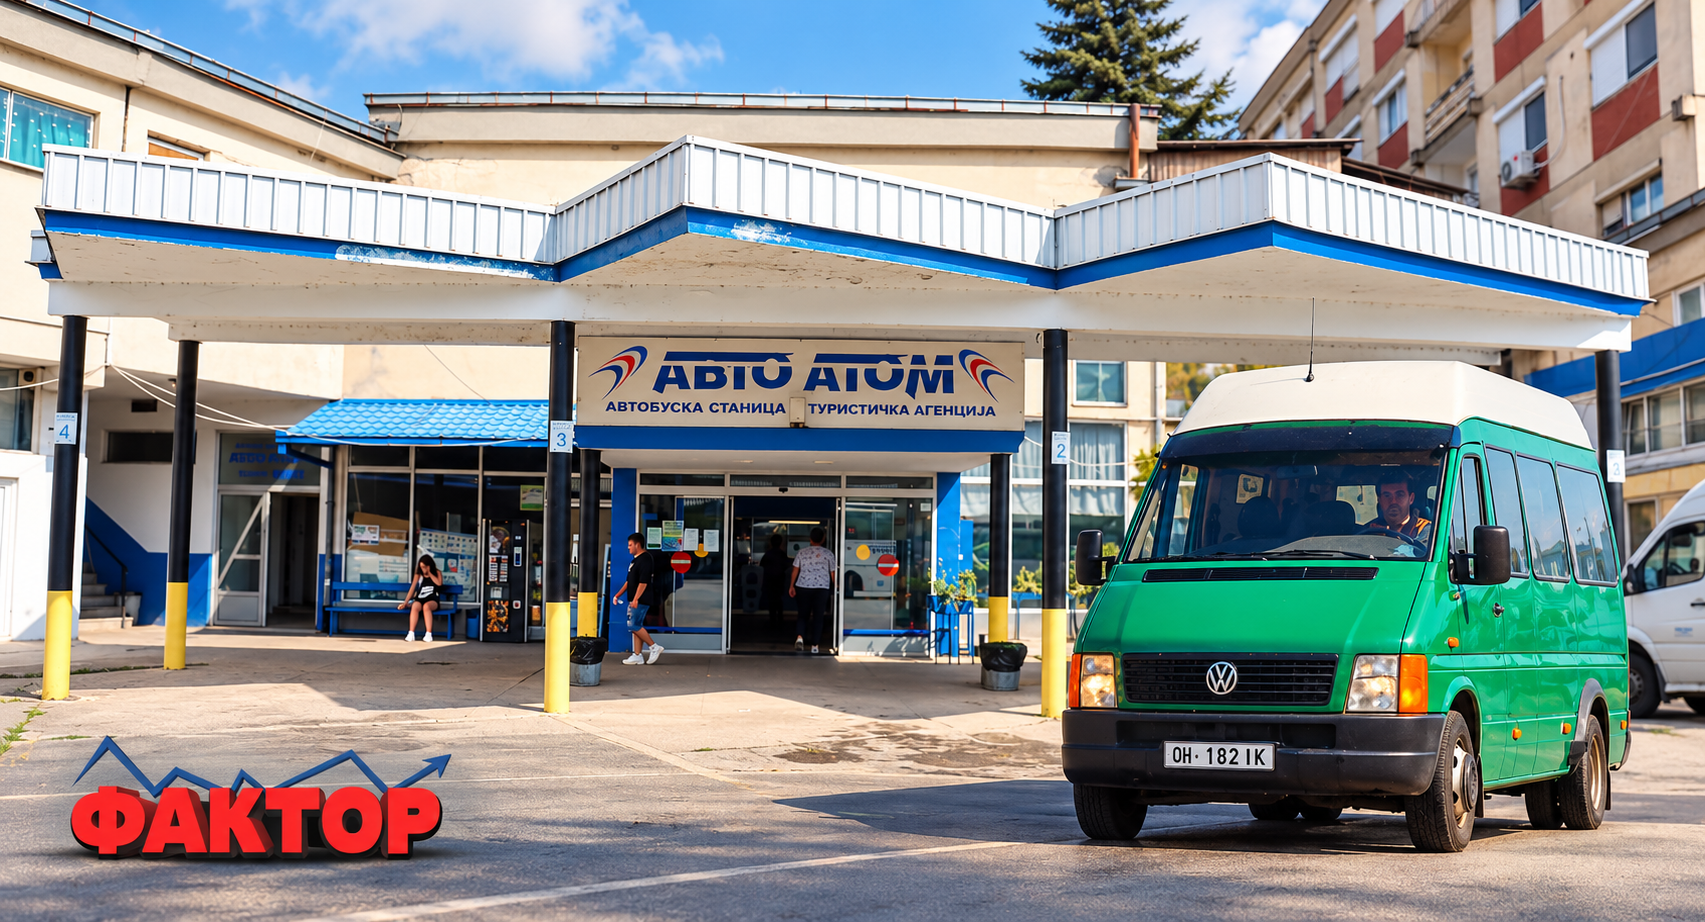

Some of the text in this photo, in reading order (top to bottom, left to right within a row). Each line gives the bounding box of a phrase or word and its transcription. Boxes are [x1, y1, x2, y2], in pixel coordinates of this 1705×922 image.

[652, 351, 955, 400] АВТО АТОМ
[605, 401, 787, 415] АВТОБУСКА СТАНИЦА
[808, 403, 997, 418] ТУРИСТИЧКА АГЕНЦИЈА
[59, 424, 70, 439] 4
[556, 432, 567, 447] 3
[1056, 443, 1067, 459] 2
[1172, 746, 1266, 766] OH 182 IK
